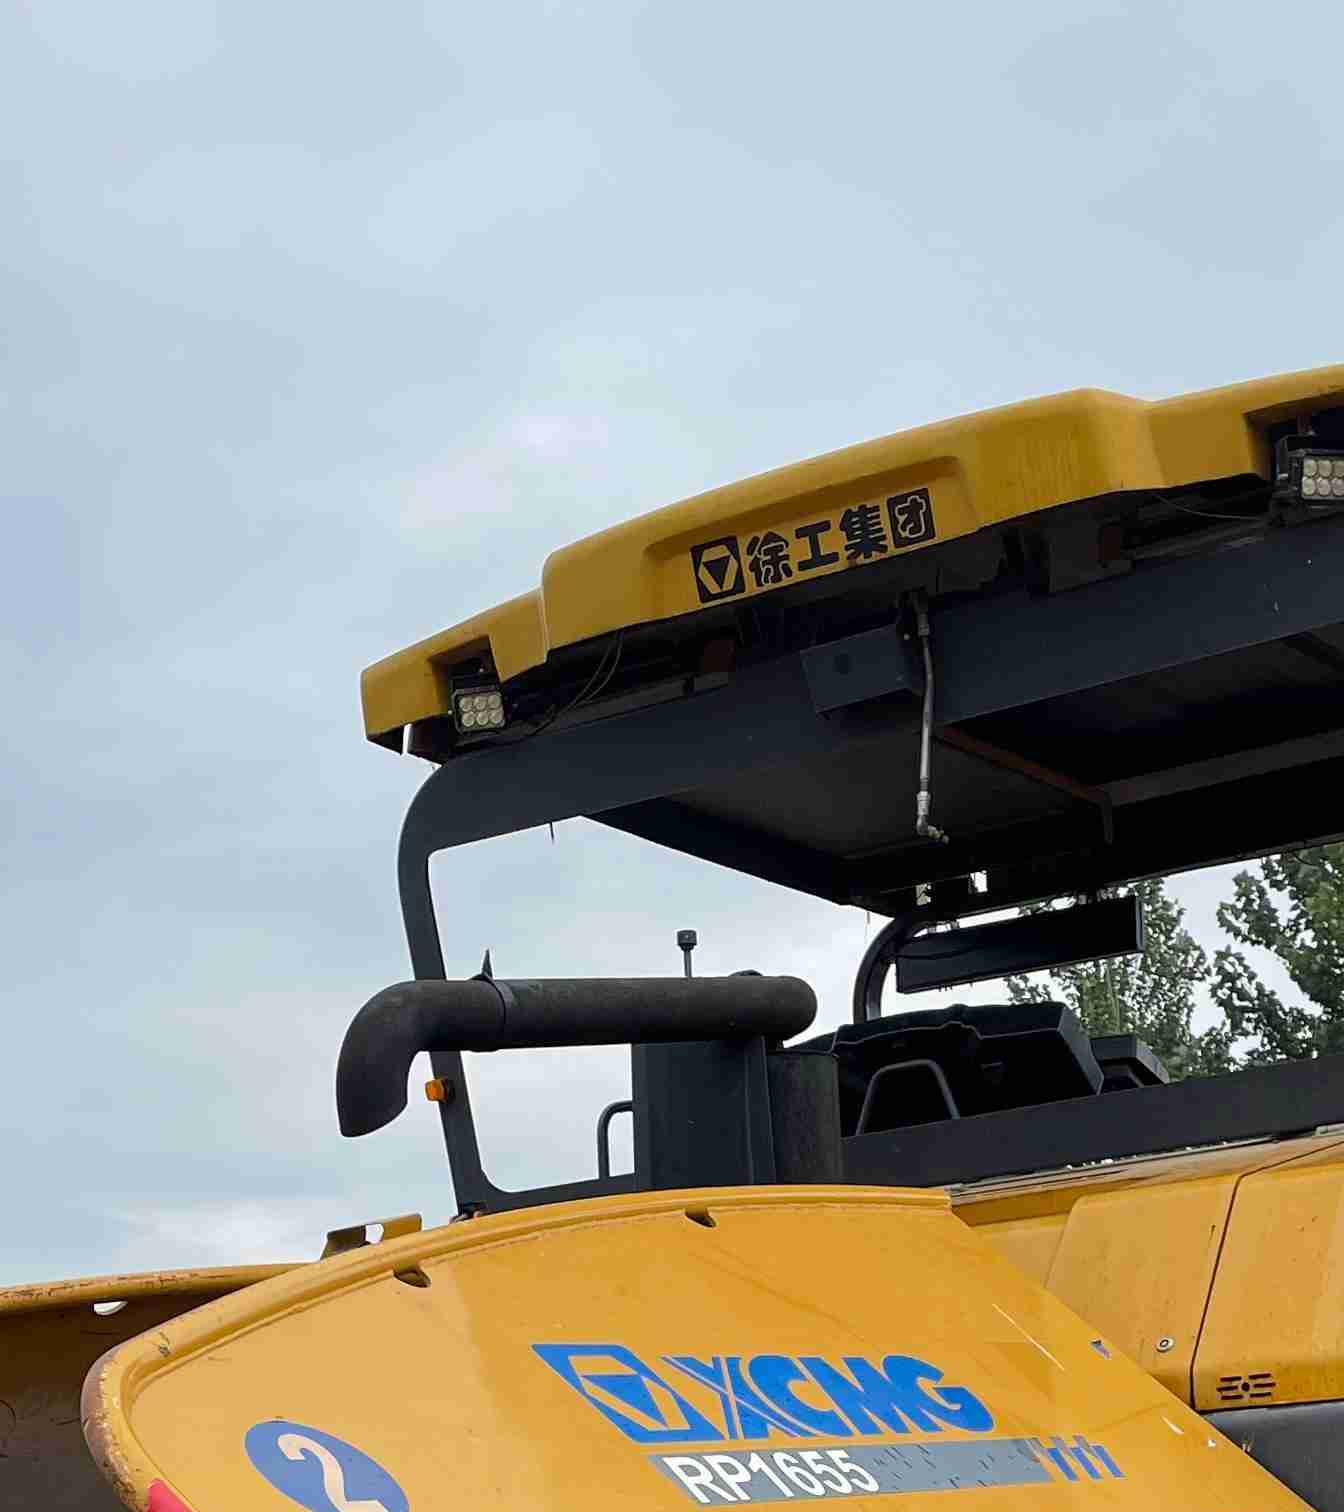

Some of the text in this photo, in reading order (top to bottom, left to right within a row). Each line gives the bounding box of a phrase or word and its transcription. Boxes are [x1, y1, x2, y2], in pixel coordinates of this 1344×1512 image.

[746, 487, 937, 587] 徐工集团
[660, 1355, 995, 1439] XCMG
[669, 1448, 880, 1505] RP1655
